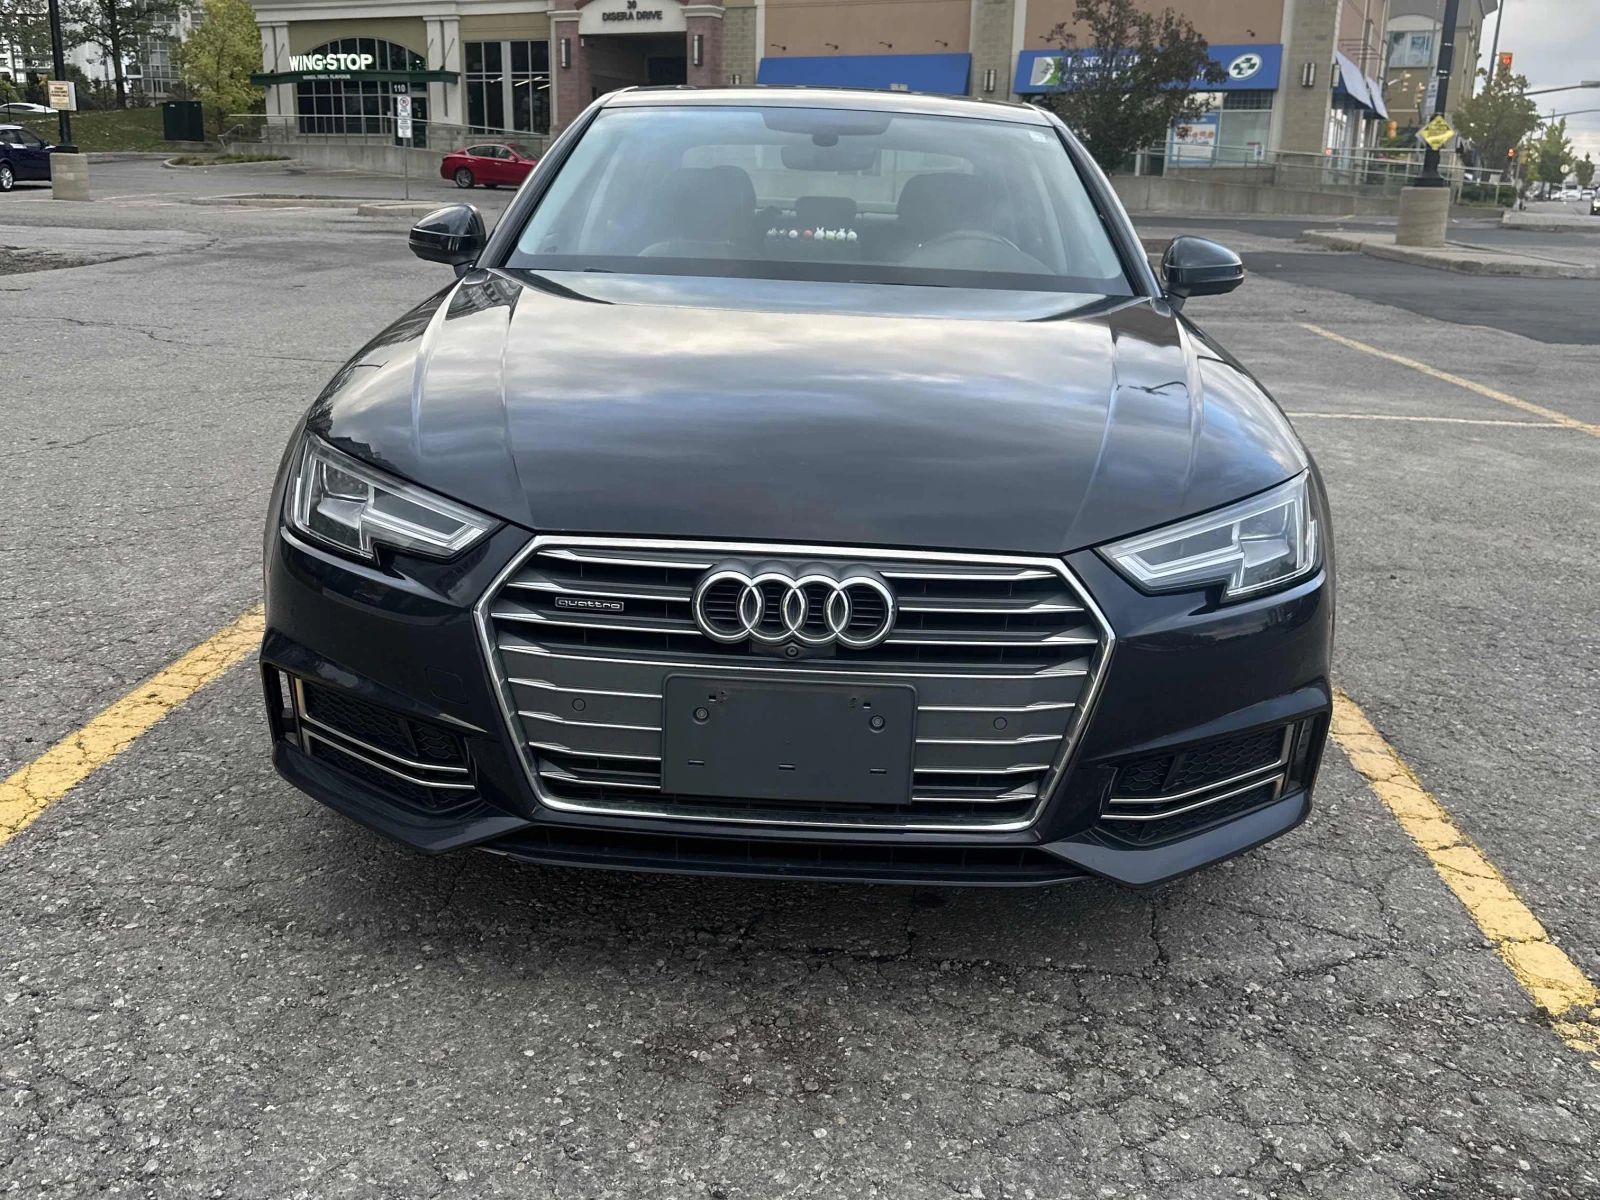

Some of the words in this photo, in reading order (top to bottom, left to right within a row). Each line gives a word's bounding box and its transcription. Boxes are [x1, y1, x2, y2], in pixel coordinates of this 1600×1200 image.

[602, 12, 634, 21] DISERA
[636, 11, 662, 20] DRIVE
[394, 84, 406, 92] 110
[558, 599, 620, 609] quattro
